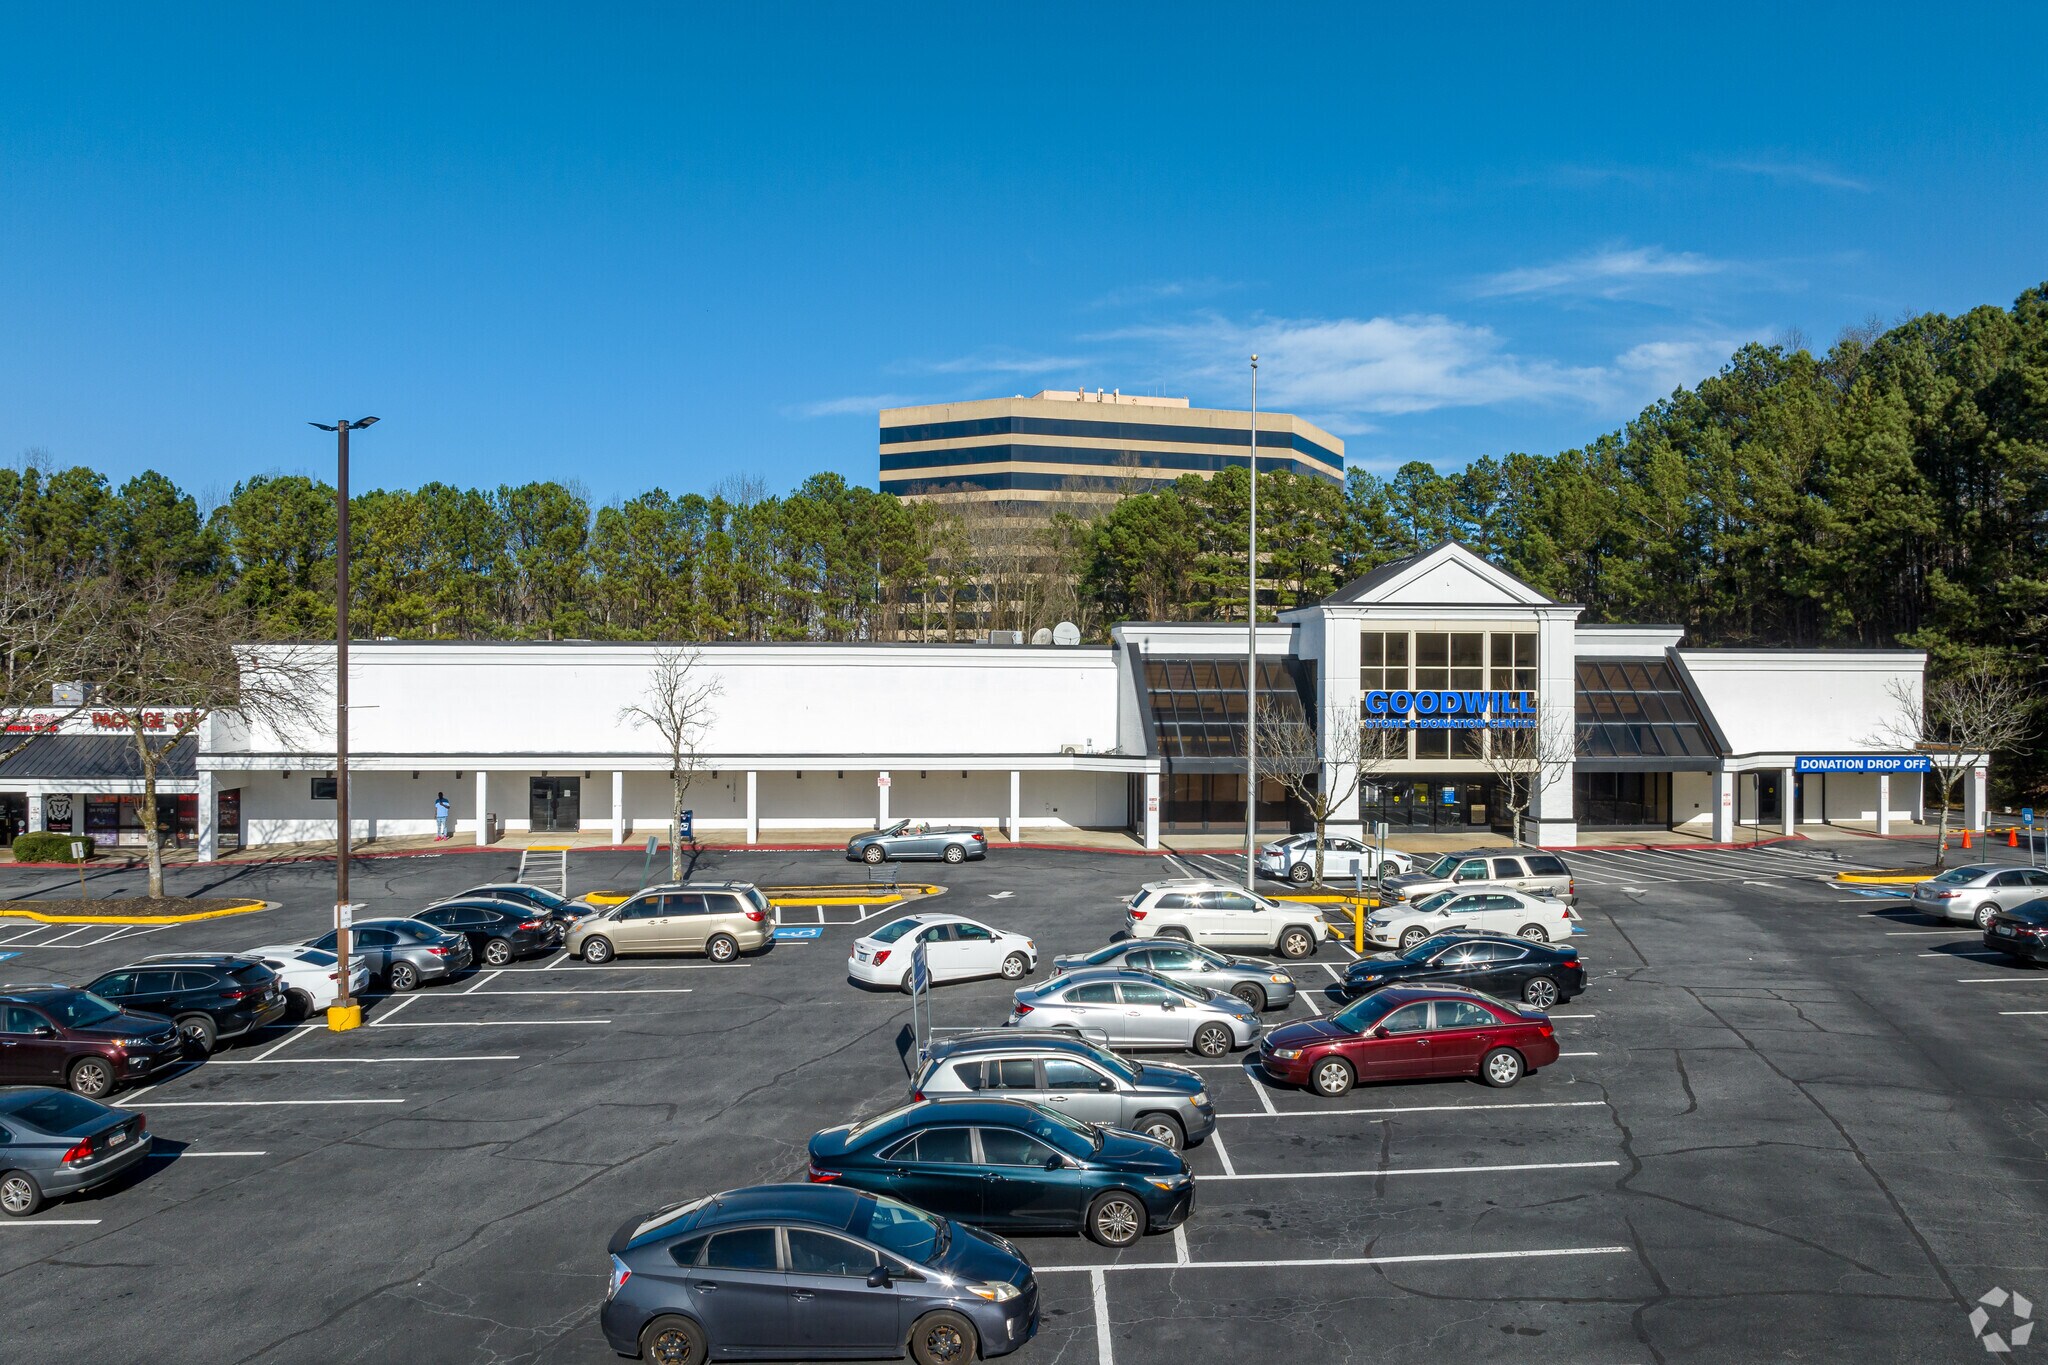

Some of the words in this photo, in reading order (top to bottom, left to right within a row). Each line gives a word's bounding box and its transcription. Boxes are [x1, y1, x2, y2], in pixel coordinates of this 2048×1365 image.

[1365, 690, 1537, 714] GOODWILL
[92, 711, 165, 729] PACKGE
[1365, 718, 1405, 729] STORE
[1409, 718, 1420, 729] &
[1421, 718, 1486, 729] DONATION
[1489, 718, 1537, 729] CENTER
[1801, 759, 1864, 769] DONATION
[1867, 759, 1901, 769] DROP
[1904, 759, 1926, 769] OFF
